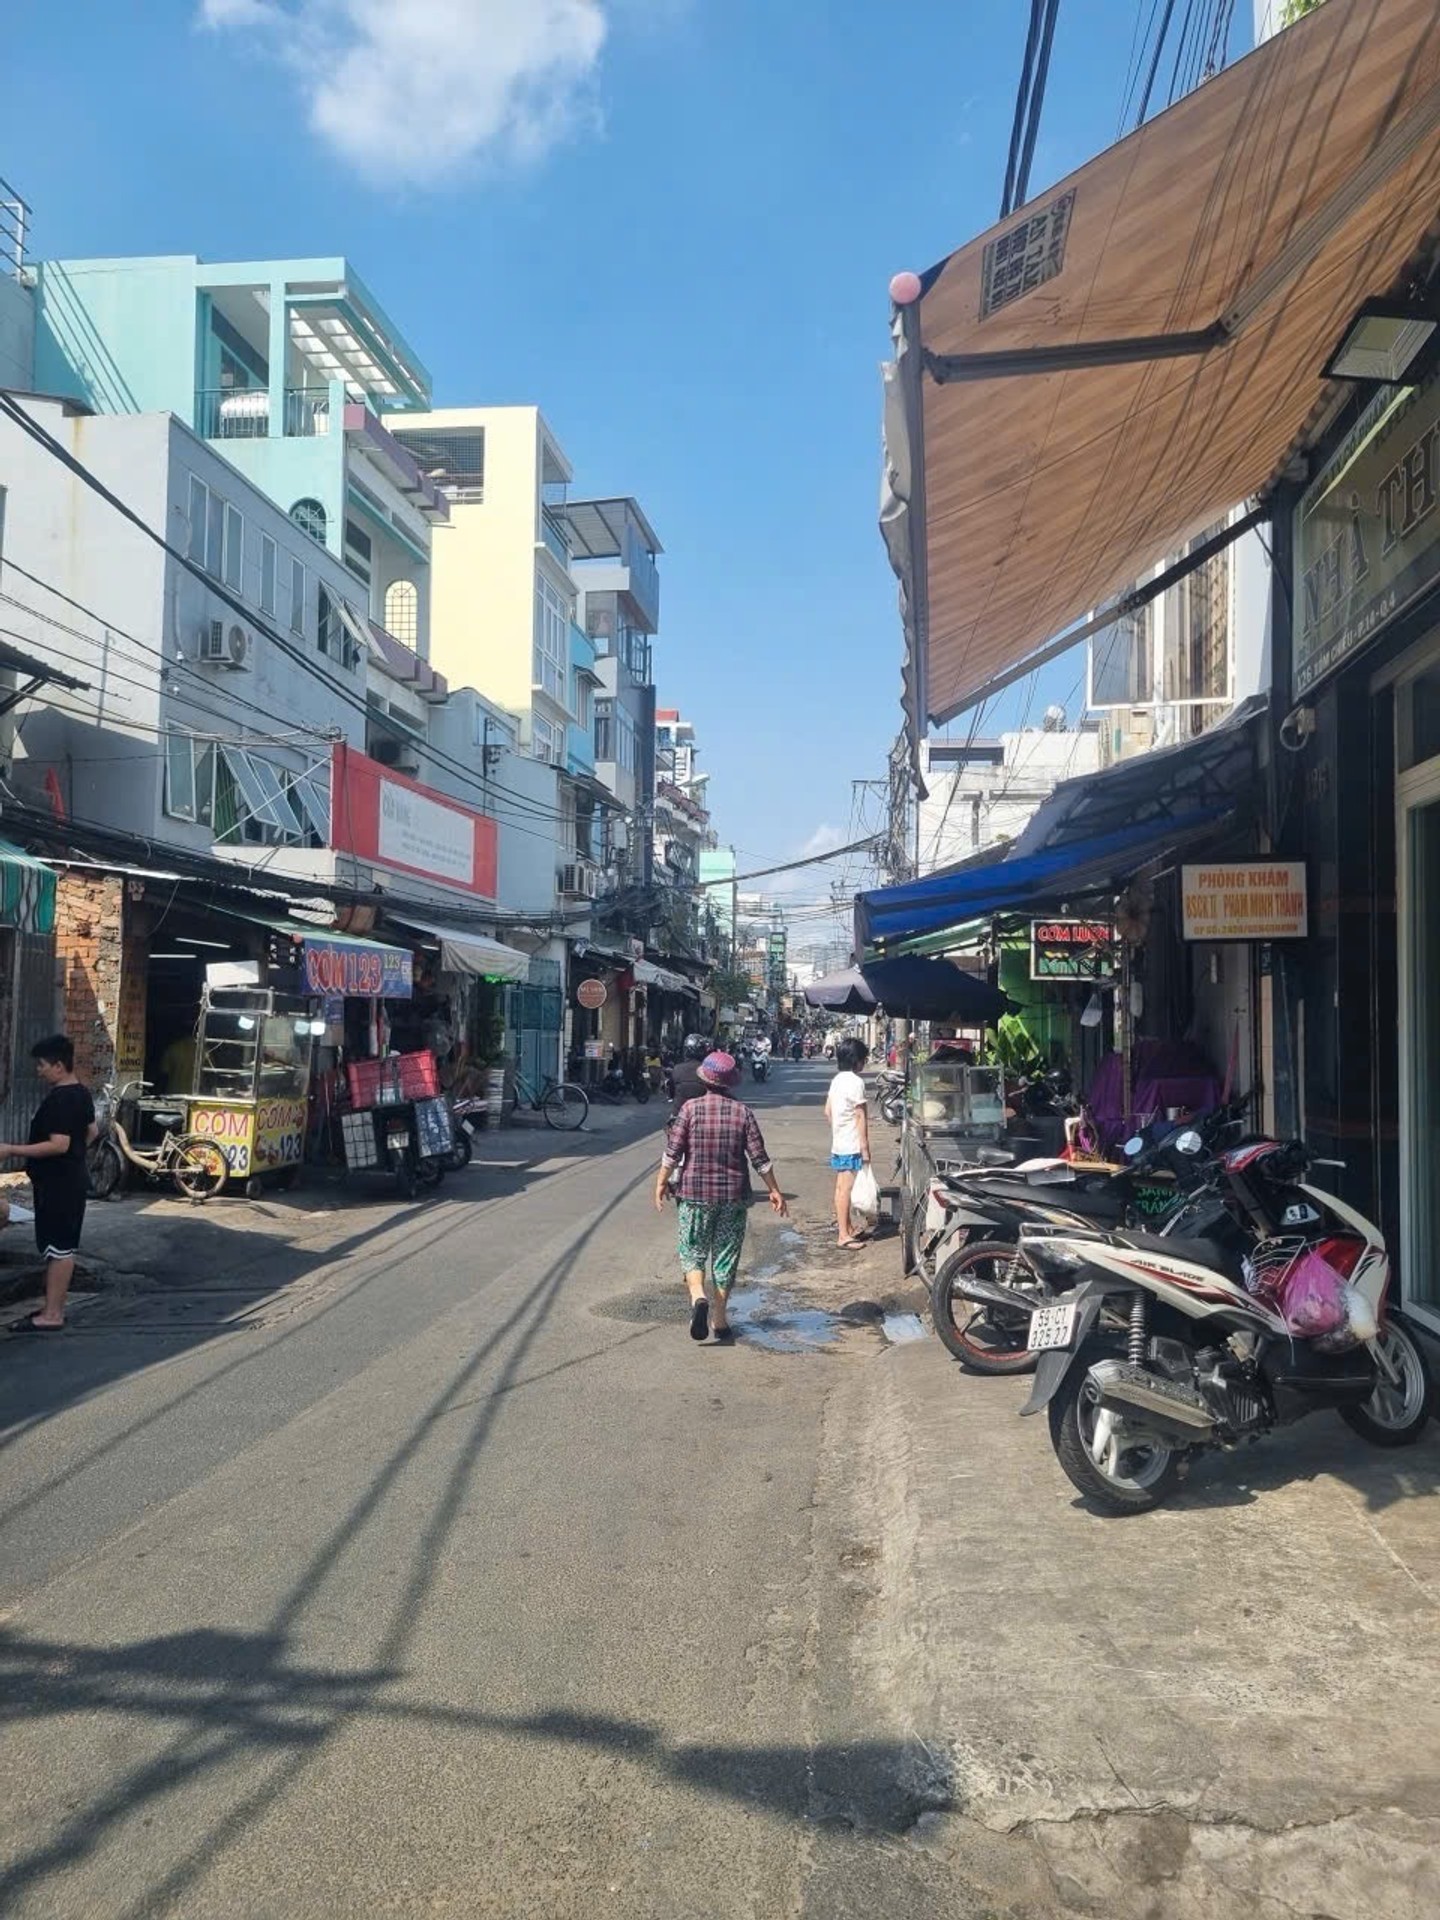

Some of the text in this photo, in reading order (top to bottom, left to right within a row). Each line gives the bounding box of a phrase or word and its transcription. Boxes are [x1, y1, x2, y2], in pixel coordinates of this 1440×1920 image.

[348, 952, 383, 993] 123
[223, 1144, 249, 1171] 23
[280, 1133, 303, 1161] 123
